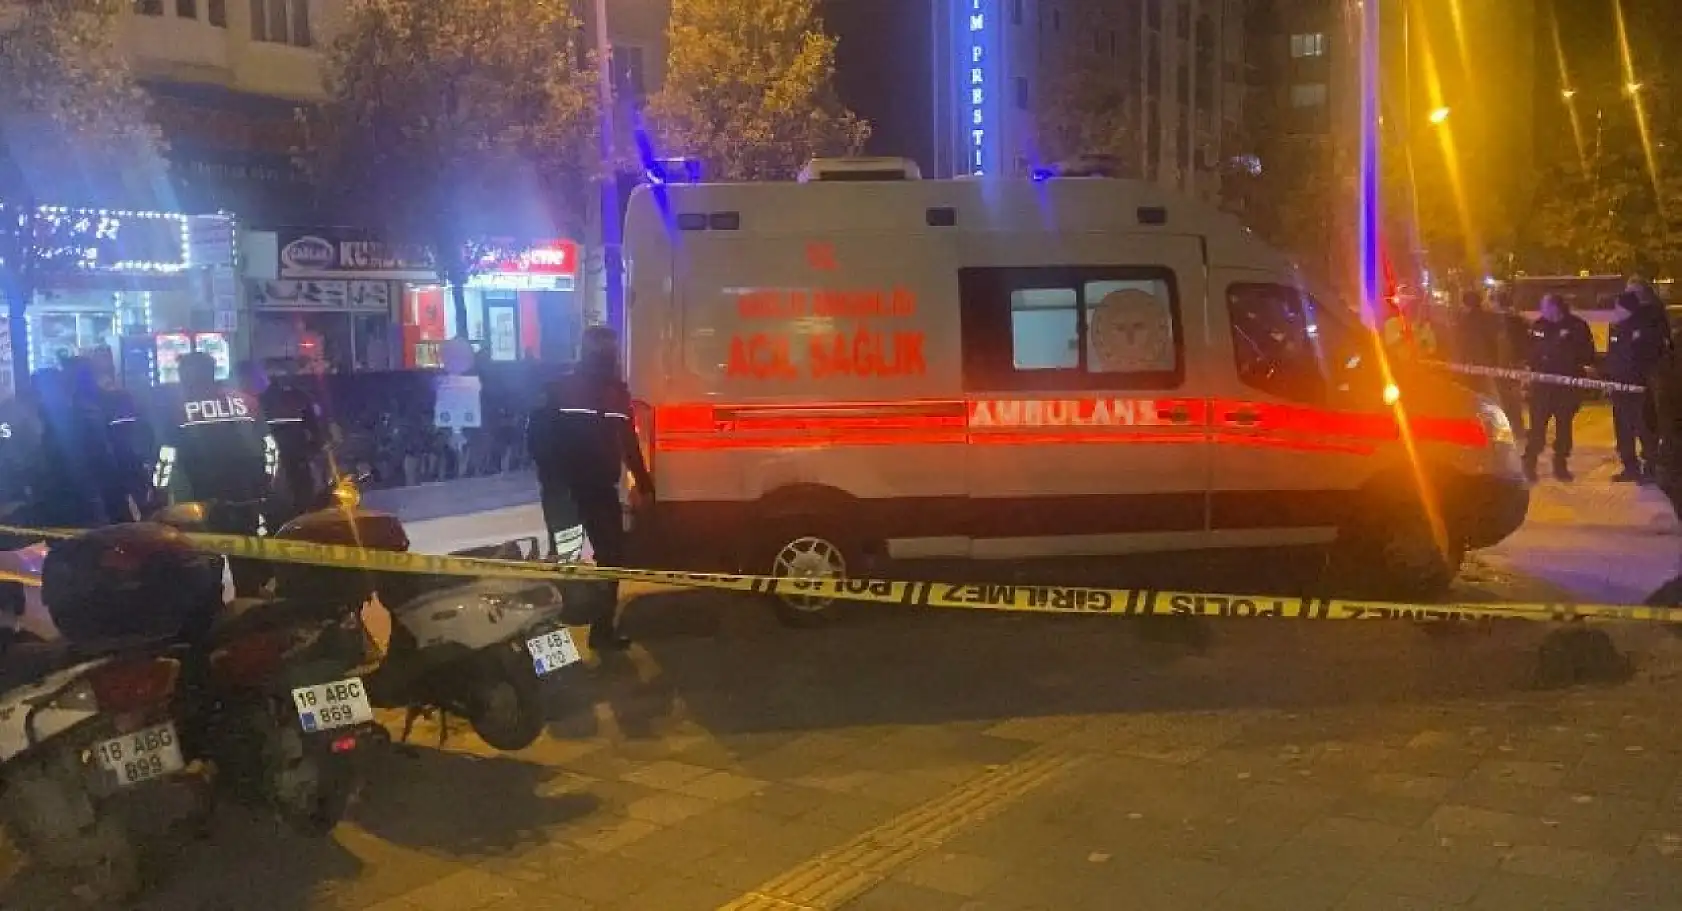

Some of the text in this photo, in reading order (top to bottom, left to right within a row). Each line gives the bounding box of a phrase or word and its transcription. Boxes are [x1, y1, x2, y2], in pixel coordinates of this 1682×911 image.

[969, 399, 1157, 427] AMBULANS
[298, 683, 360, 708] 18 ABC
[320, 704, 353, 722] 869
[100, 741, 122, 763] 18
